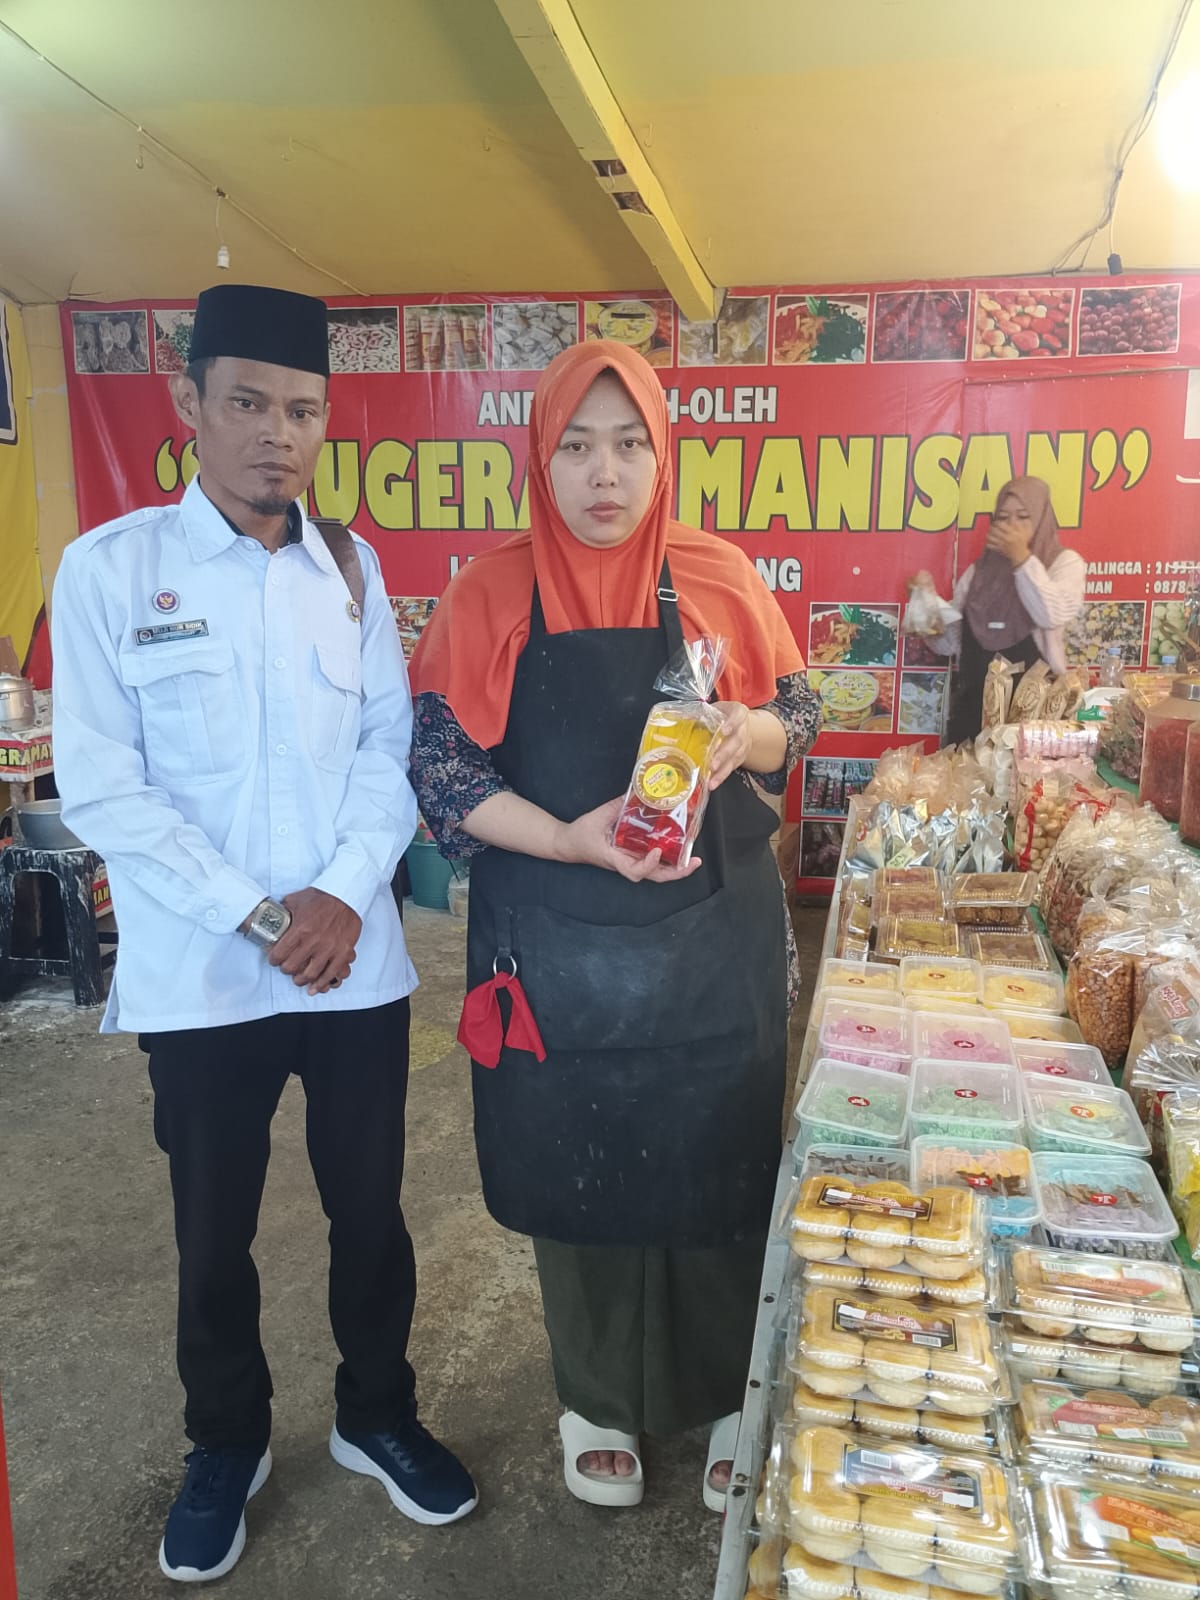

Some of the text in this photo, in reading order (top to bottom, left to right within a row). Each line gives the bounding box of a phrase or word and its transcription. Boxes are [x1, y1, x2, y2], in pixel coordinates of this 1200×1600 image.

[666, 386, 778, 425] H-OLEH
[1084, 560, 1142, 576] ALINGGA
[1153, 580, 1187, 595] 0878
